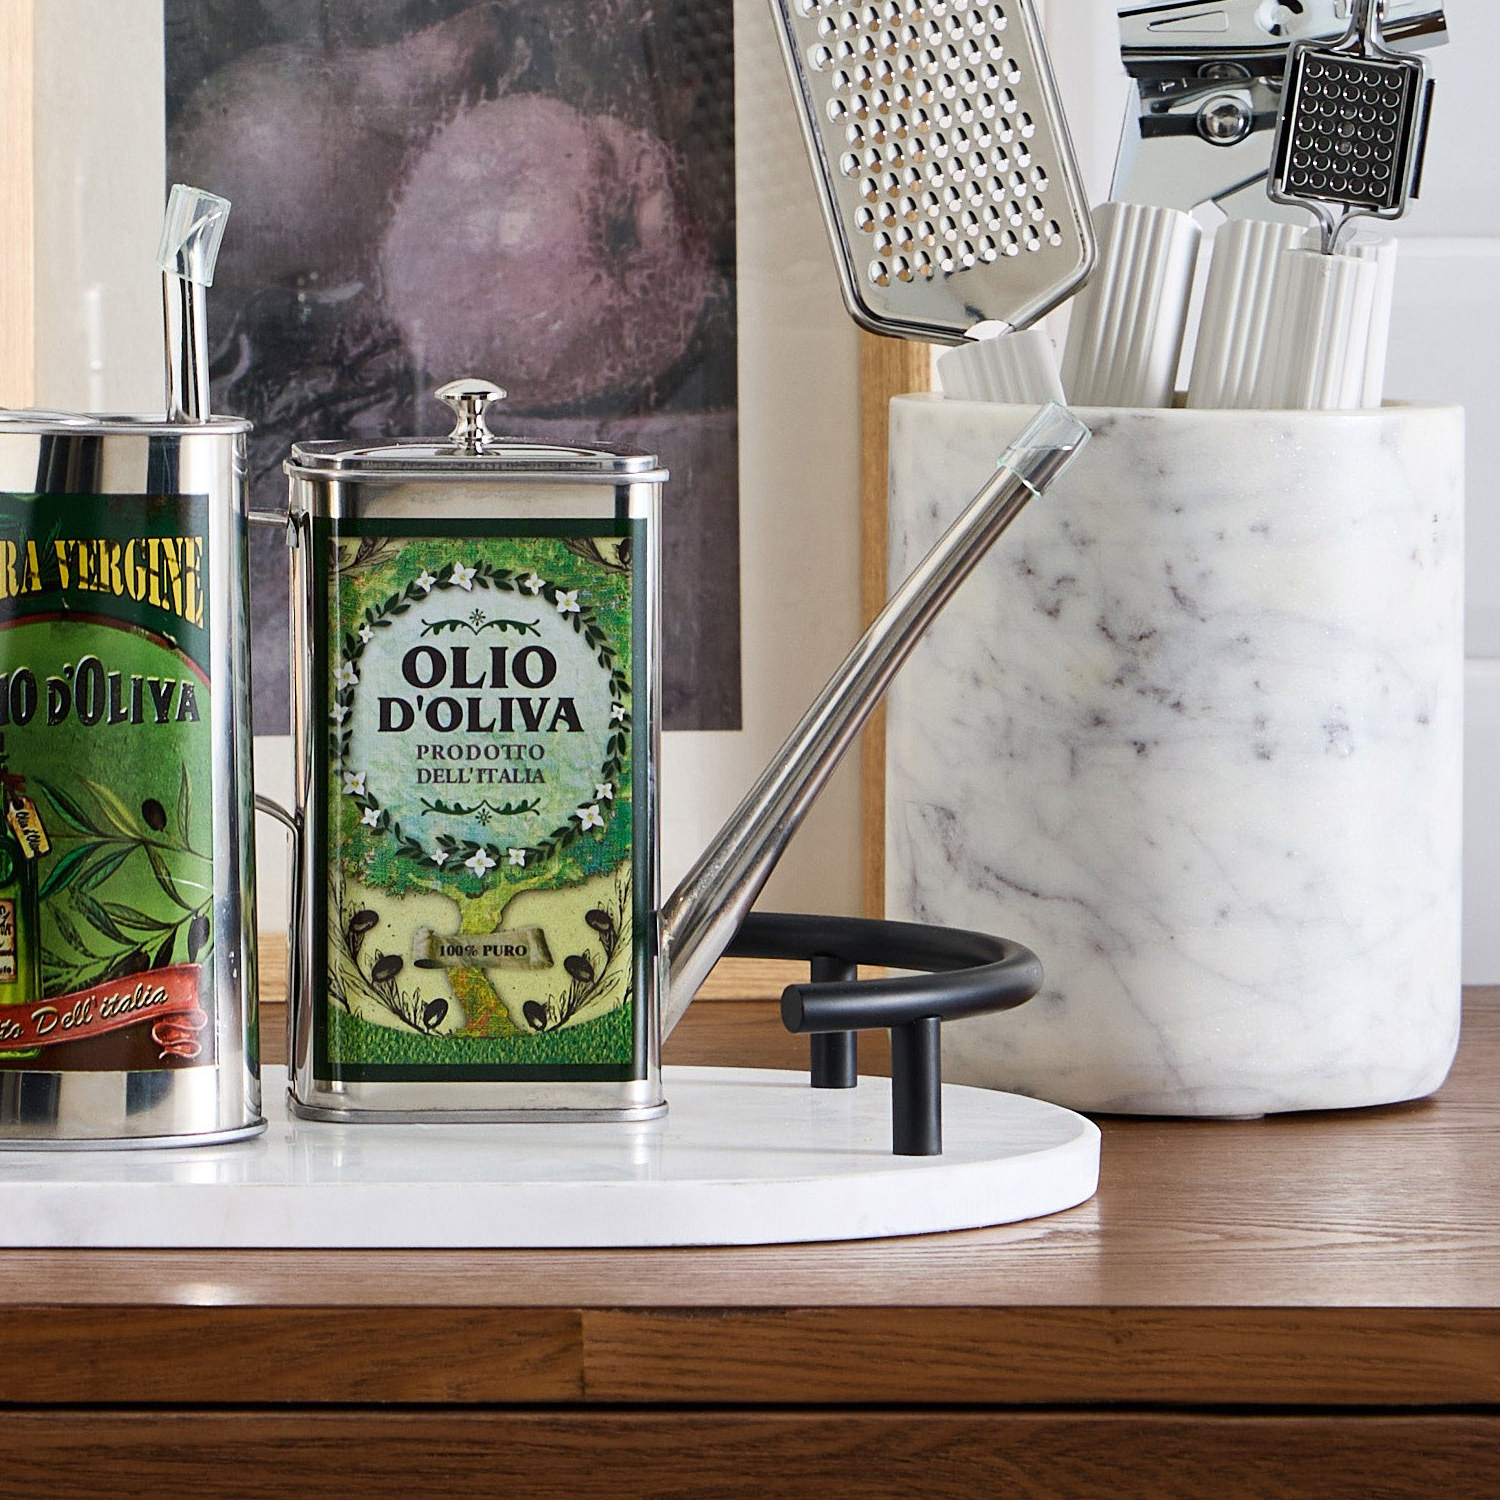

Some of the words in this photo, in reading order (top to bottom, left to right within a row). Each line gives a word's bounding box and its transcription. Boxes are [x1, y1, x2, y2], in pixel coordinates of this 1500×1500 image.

[54, 535, 205, 630] VERGINE
[401, 644, 558, 690] OLIO
[377, 694, 585, 733] D'OLIVA
[416, 743, 546, 761] PRODOTTO
[416, 766, 546, 785] DELL'ITALIA
[439, 944, 479, 958] 100%
[482, 944, 528, 958] PURO
